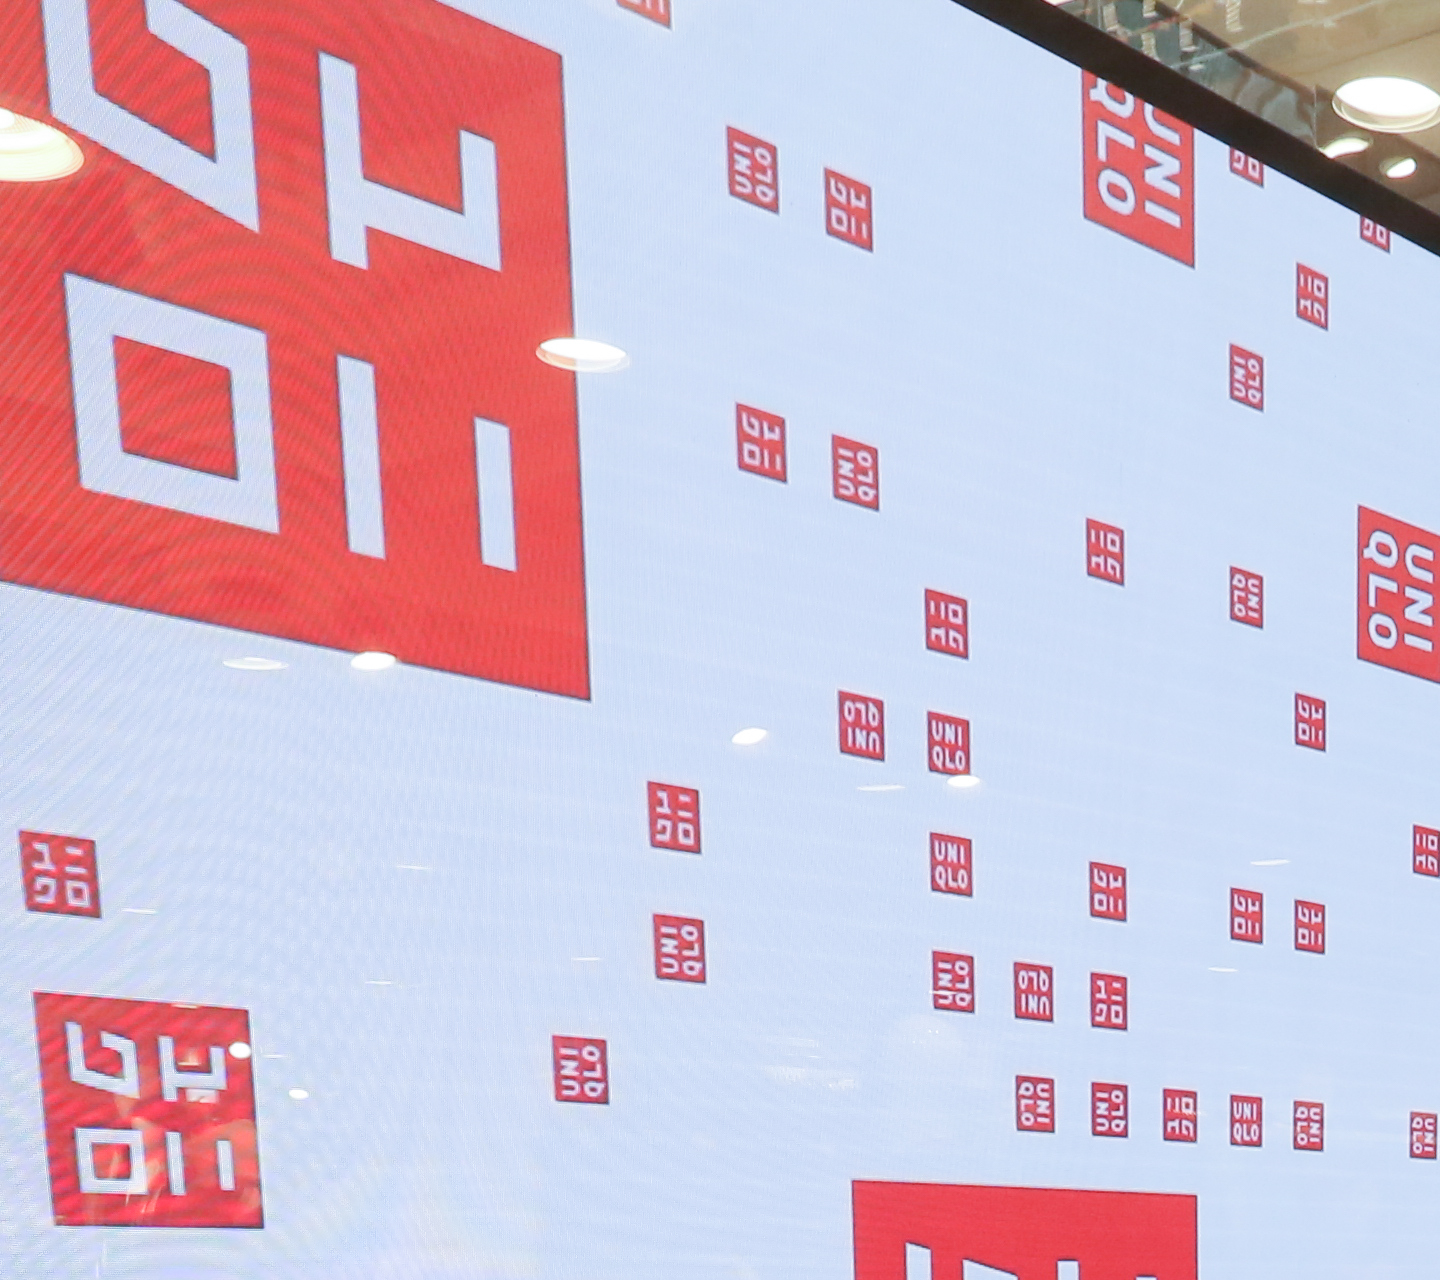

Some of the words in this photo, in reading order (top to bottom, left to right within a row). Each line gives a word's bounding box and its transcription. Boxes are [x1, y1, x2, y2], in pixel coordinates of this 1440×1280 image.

[1088, 77, 1137, 216] QLO
[319, 52, 517, 572] ユニ
[1364, 529, 1400, 648] QLO
[1403, 542, 1434, 650] UNI
[660, 927, 680, 972] UNI
[679, 924, 701, 974] QLO
[65, 1021, 148, 1194] クロ
[158, 1035, 233, 1195] ユニ
[560, 1047, 581, 1094] UNI
[582, 1046, 604, 1095] QLO
